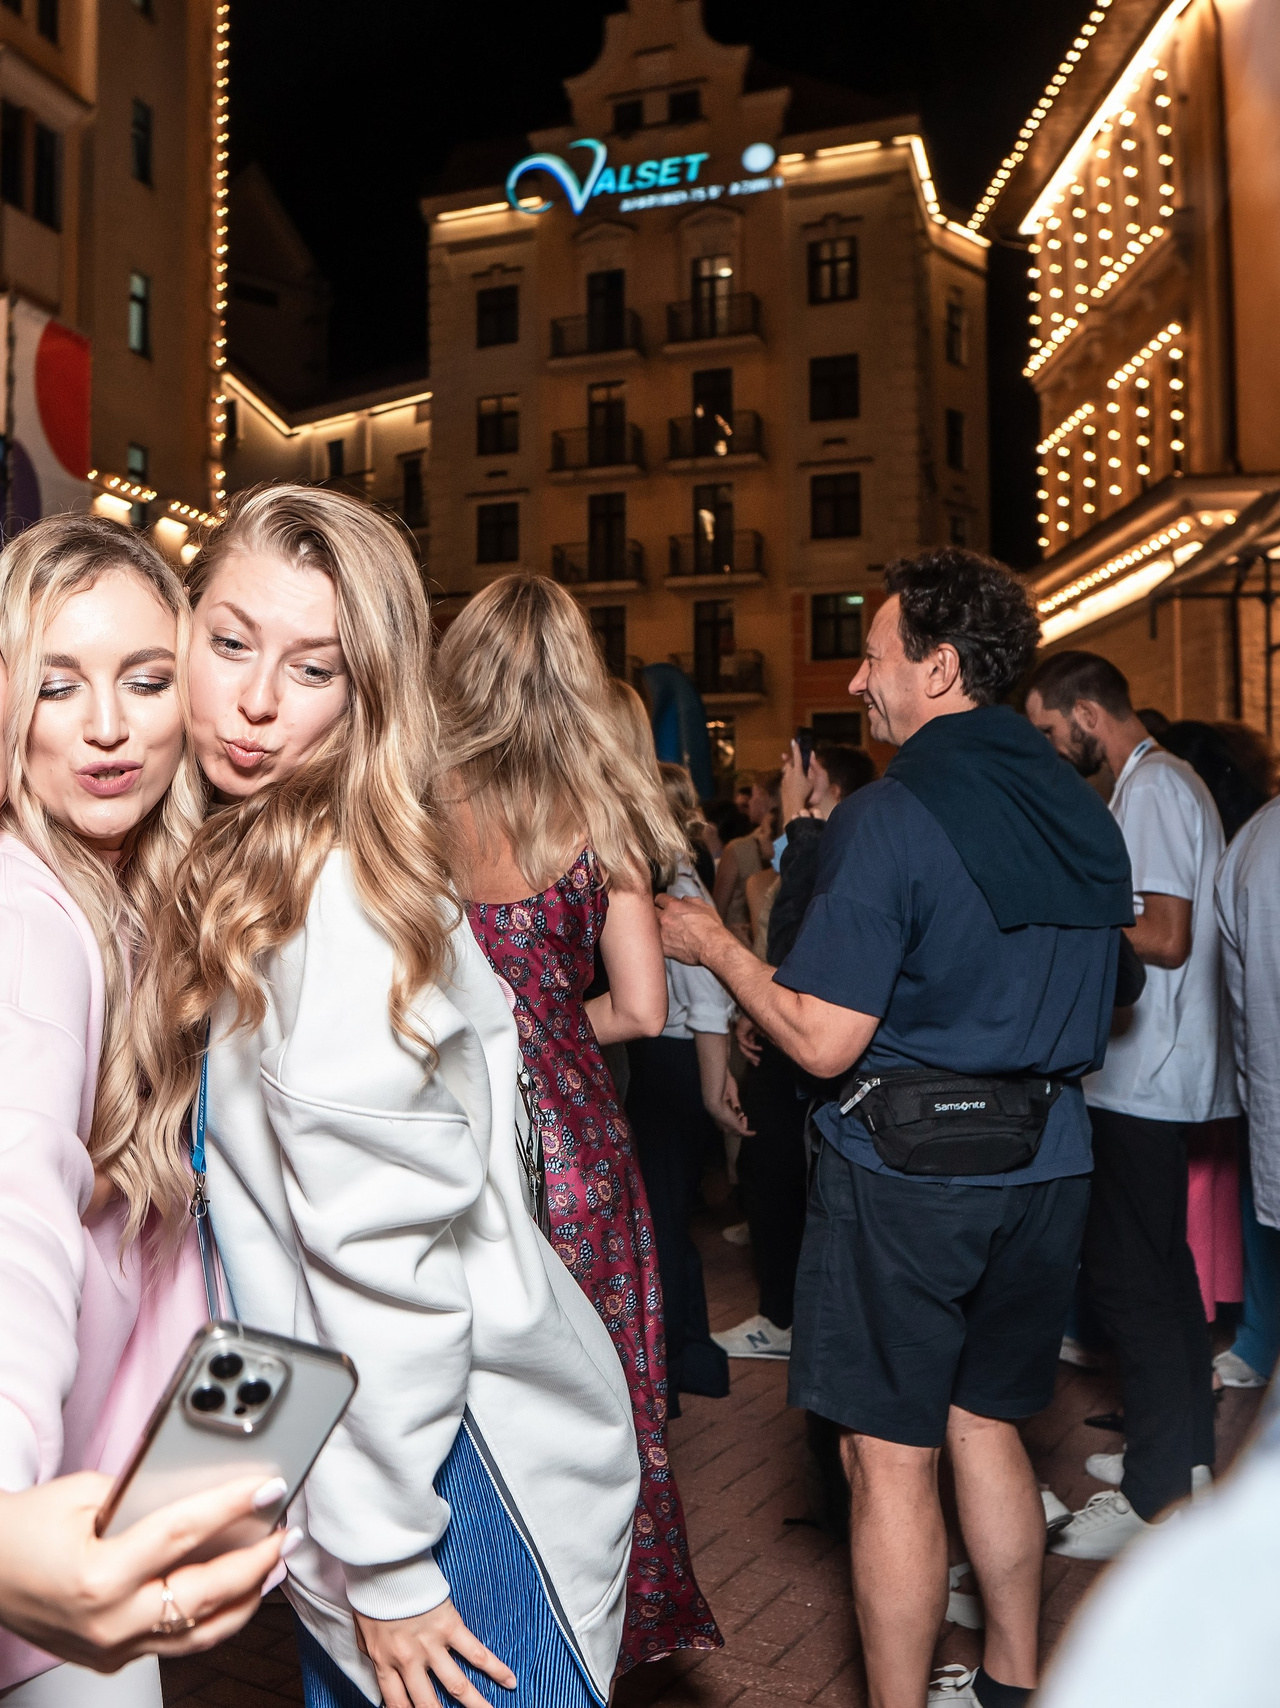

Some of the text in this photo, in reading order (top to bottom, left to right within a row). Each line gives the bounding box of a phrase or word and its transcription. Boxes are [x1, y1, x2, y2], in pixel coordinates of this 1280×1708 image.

[506, 138, 709, 215] VALSET
[934, 1101, 986, 1112] Samsonite
[745, 1330, 771, 1349] N
